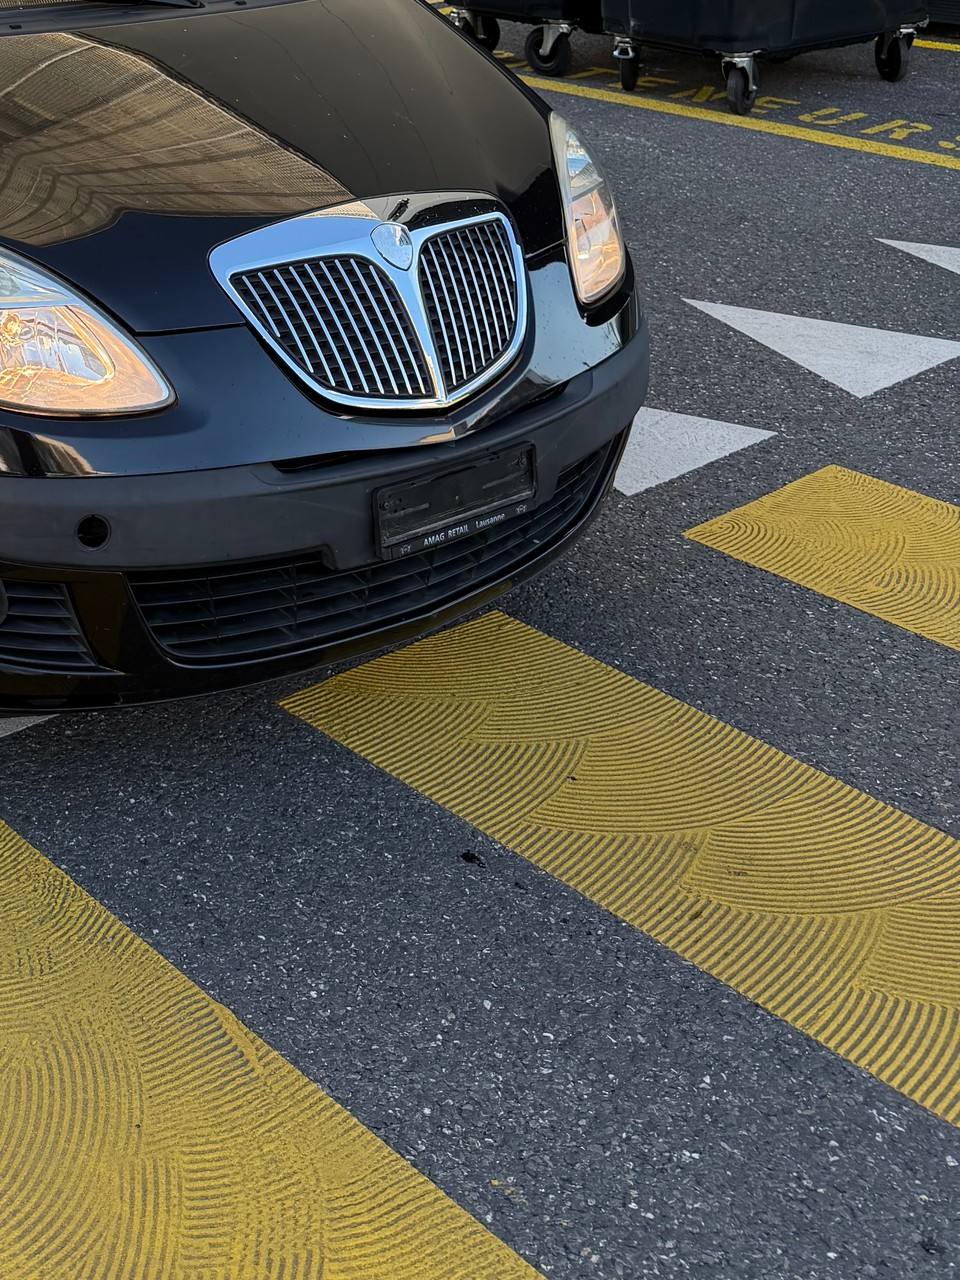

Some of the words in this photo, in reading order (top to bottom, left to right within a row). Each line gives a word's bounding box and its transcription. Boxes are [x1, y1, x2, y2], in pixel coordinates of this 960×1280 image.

[423, 532, 445, 546] AMAG
[448, 524, 469, 538] RETAIL
[475, 513, 505, 528] Lausanne
